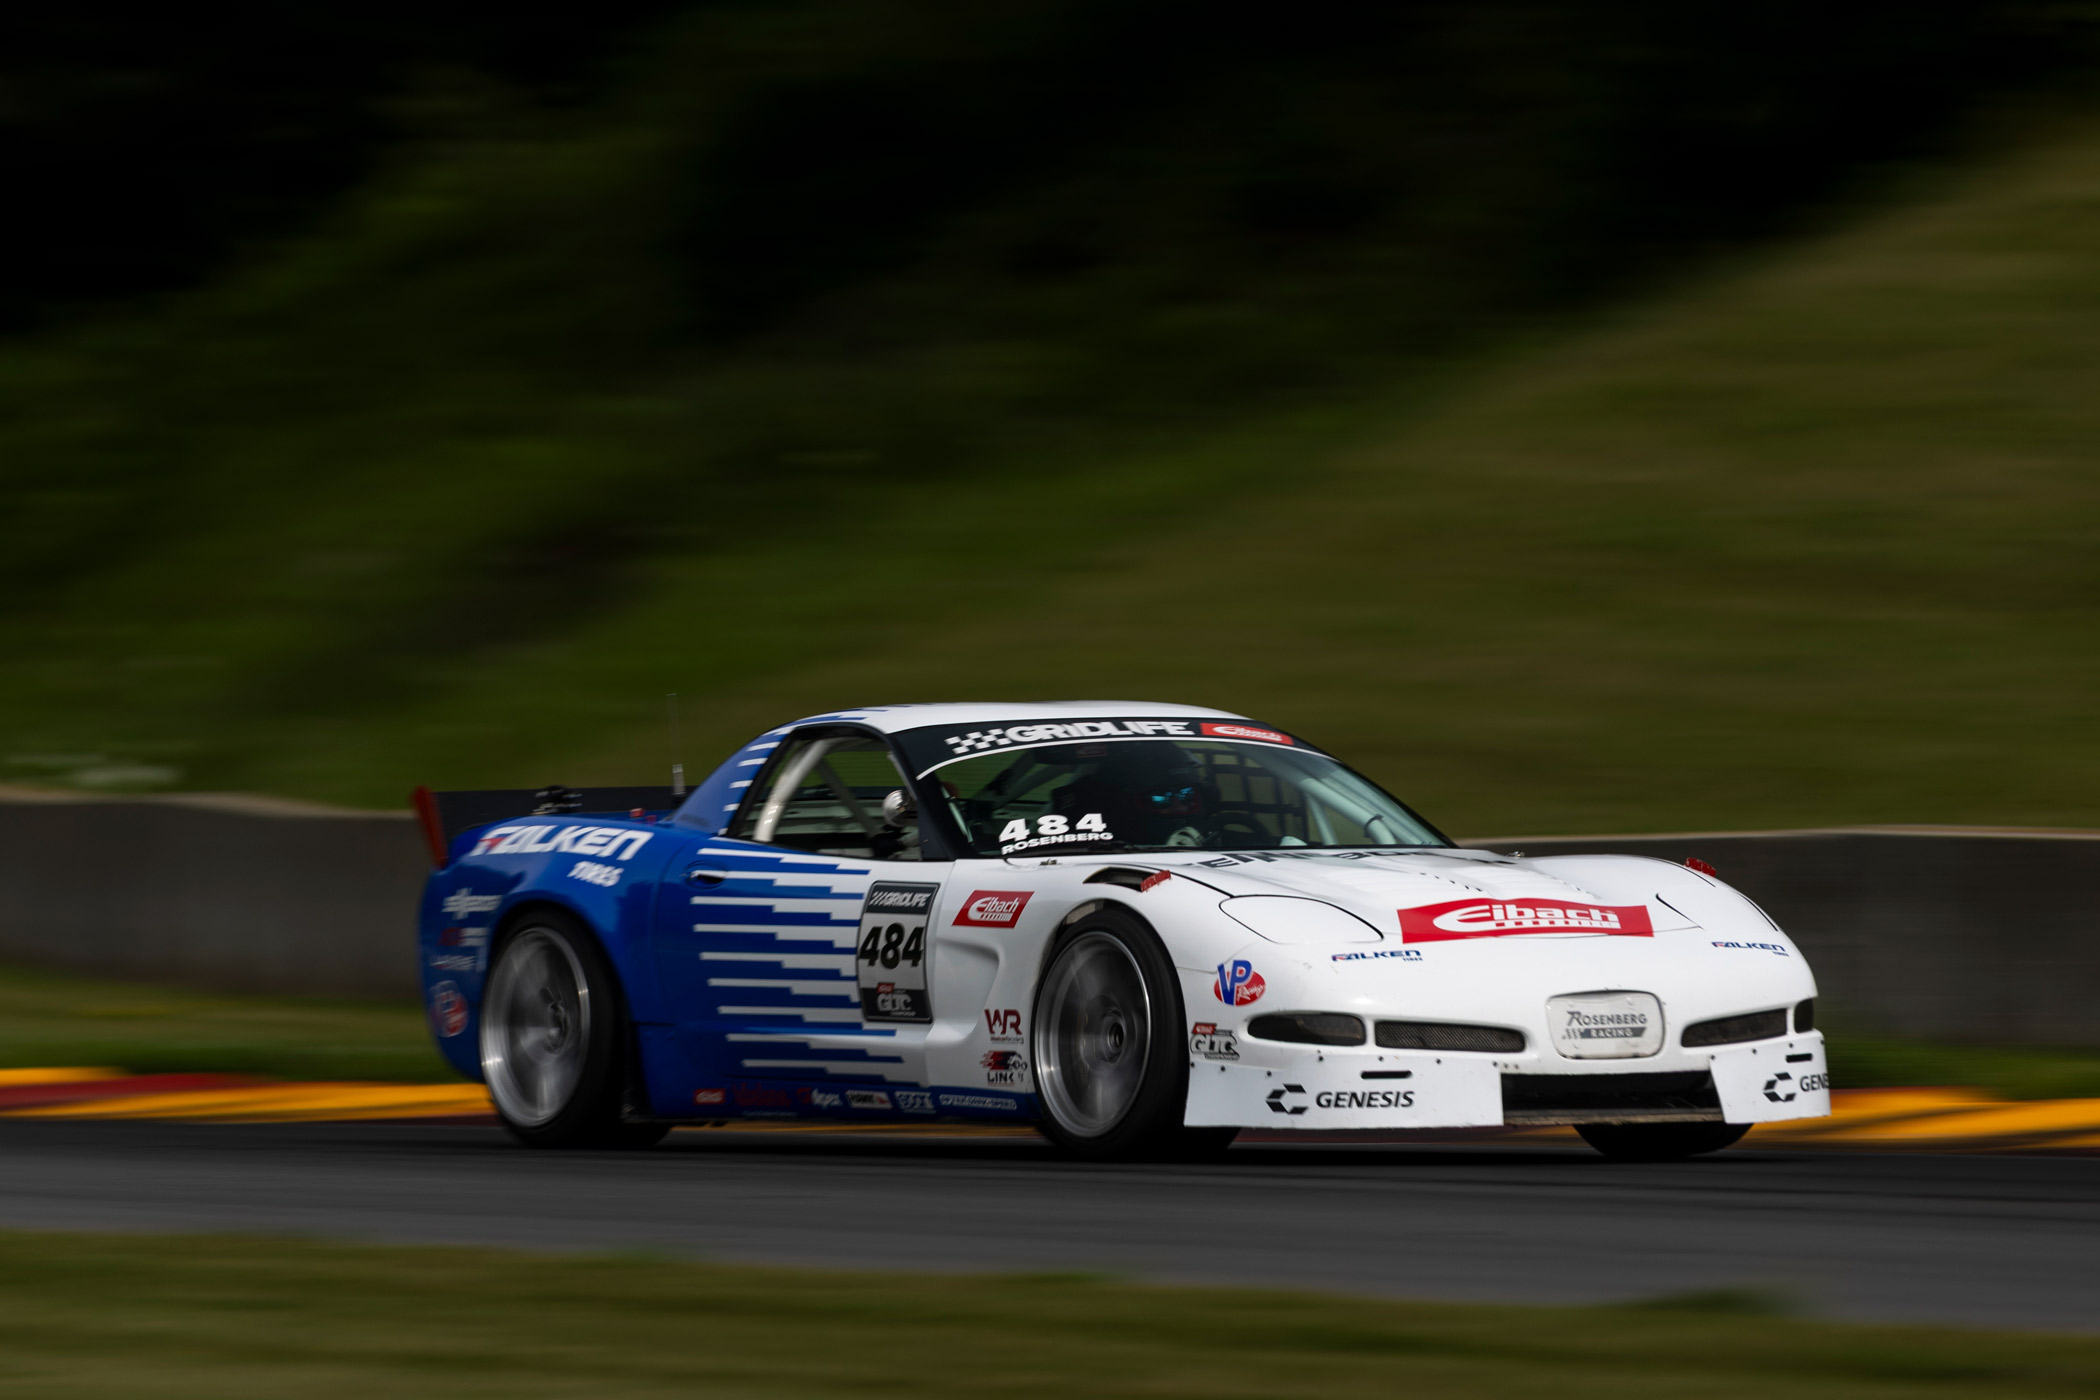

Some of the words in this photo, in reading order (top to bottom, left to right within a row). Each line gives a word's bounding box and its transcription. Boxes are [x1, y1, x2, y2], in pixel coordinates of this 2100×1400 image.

[1004, 721, 1195, 742] GRIDLIFE
[998, 813, 1107, 843] 484
[467, 825, 654, 861] FALKEN
[1001, 831, 1114, 855] ROSENBERG
[884, 892, 931, 908] GRIDLIFE
[967, 896, 1020, 922] Eibach
[1431, 904, 1621, 933] Eibach
[858, 922, 926, 970] 484
[1331, 949, 1422, 962] FALKEN
[1711, 941, 1787, 952] FALKEN
[1217, 960, 1252, 1006] VP
[984, 1009, 1022, 1035] WR
[1566, 1010, 1647, 1026] ROSENBERG
[1590, 1028, 1633, 1038] RACING
[1316, 1091, 1415, 1109] GENESIS
